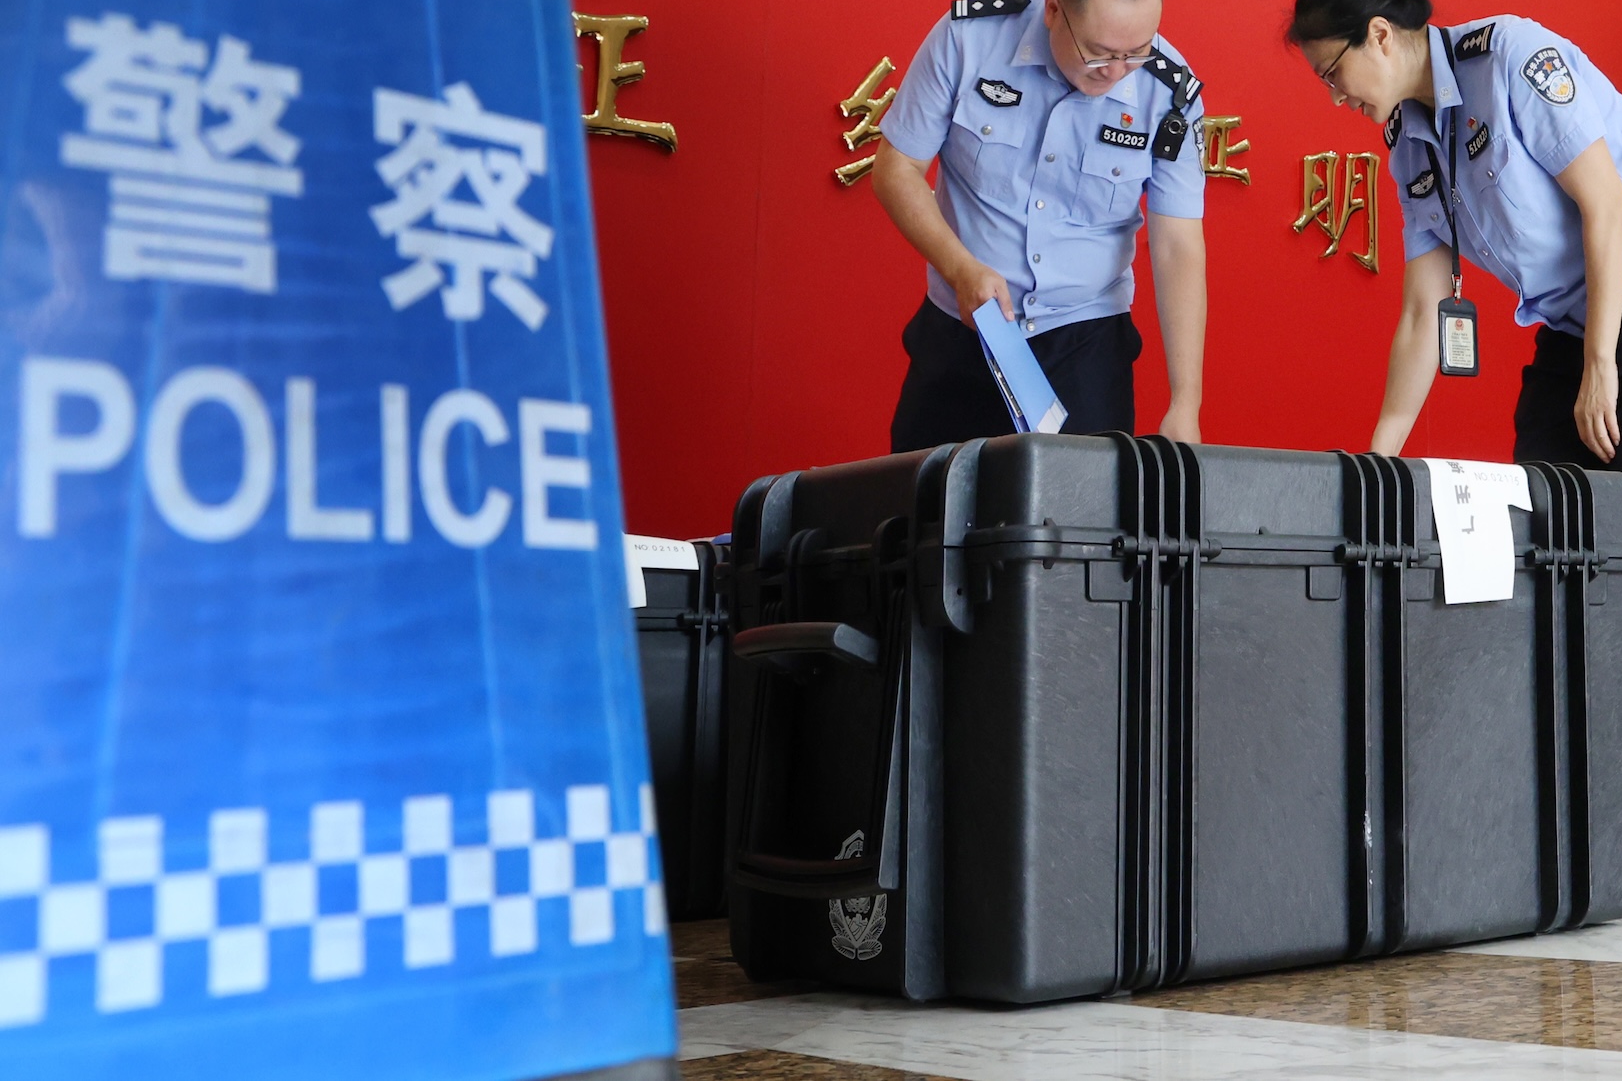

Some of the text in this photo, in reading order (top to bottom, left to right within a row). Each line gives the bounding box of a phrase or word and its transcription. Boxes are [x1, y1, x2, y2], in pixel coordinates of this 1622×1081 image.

[60, 12, 556, 332] 警察
[1103, 129, 1145, 147] 510202
[17, 356, 600, 551] POLICE
